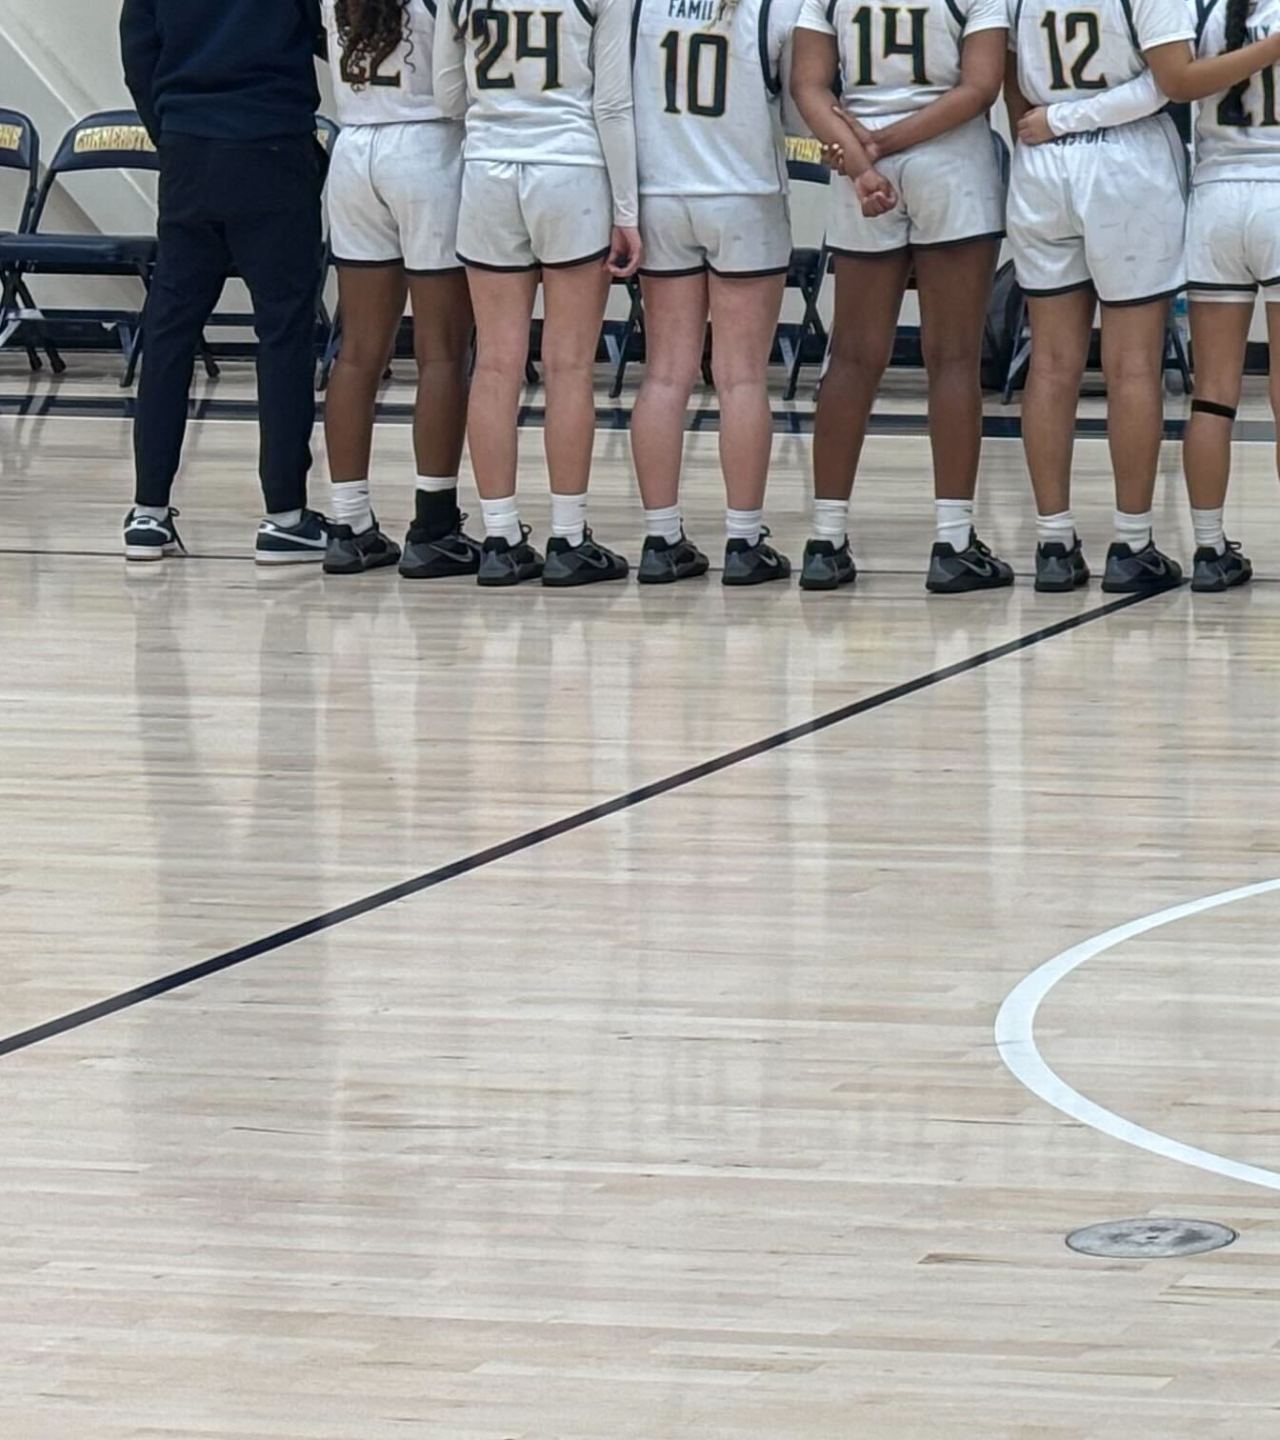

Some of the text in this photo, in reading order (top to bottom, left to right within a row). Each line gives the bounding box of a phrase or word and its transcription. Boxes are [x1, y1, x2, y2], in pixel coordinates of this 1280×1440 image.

[470, 10, 564, 90] 24
[660, 30, 729, 118] 10
[852, 6, 931, 86] 14
[1040, 10, 1108, 91] 12
